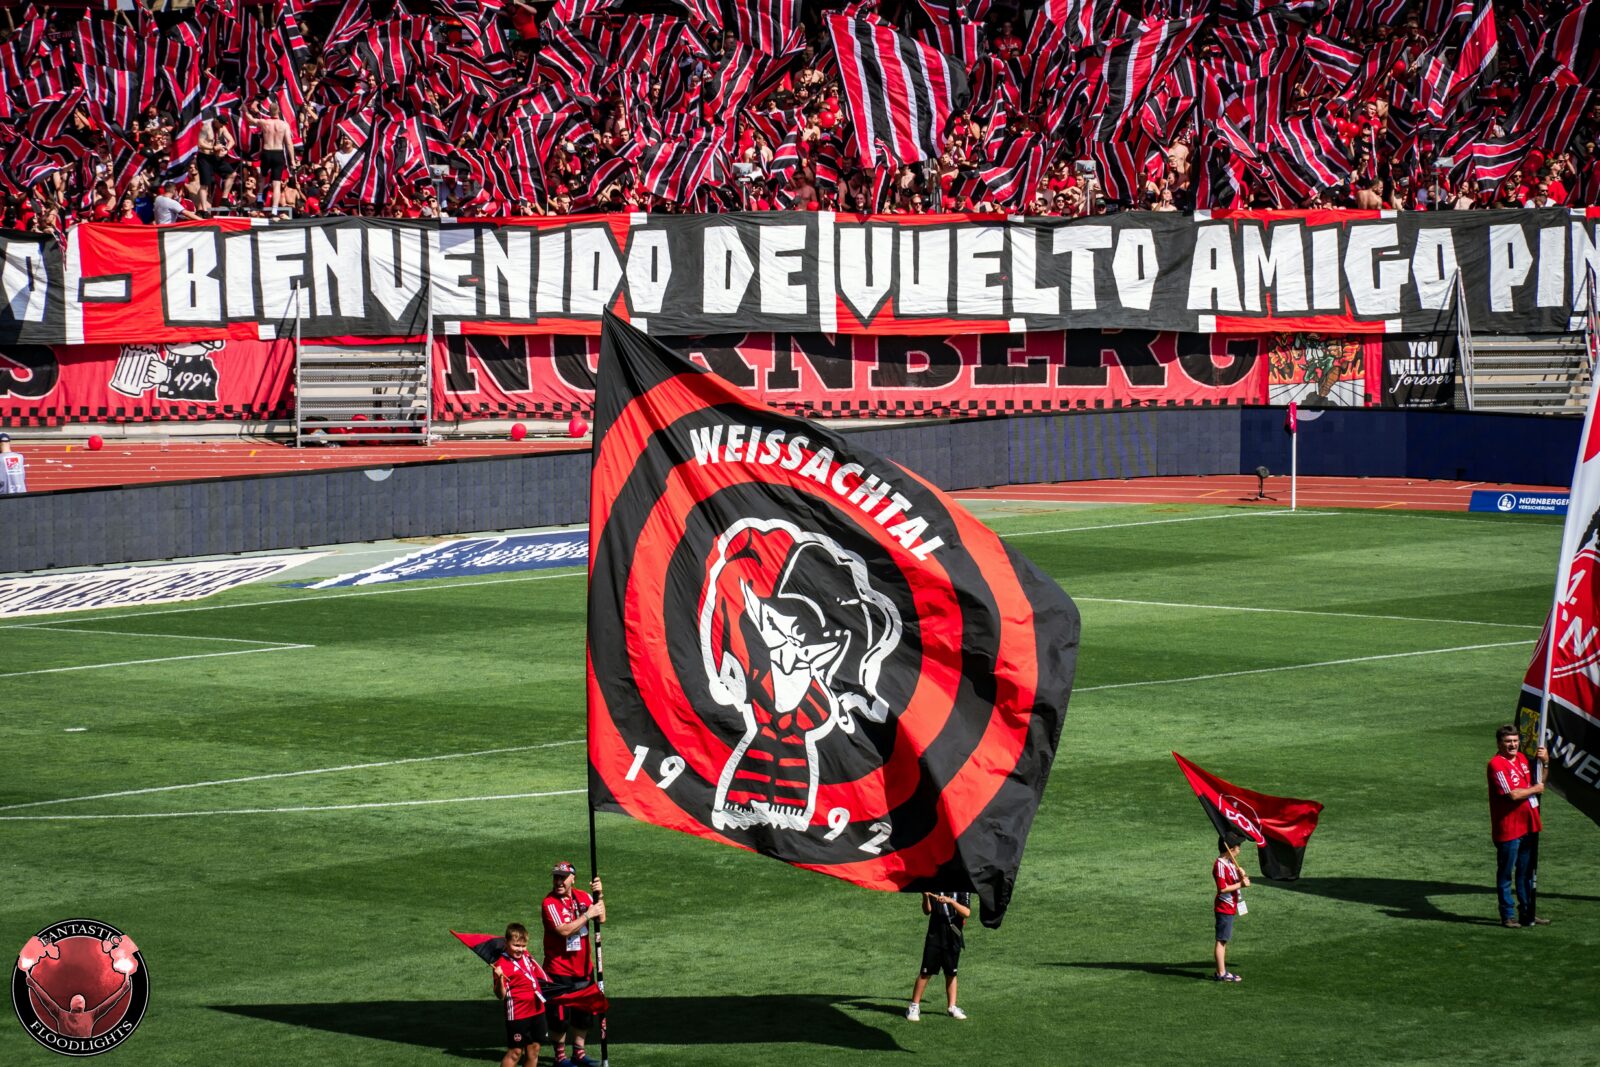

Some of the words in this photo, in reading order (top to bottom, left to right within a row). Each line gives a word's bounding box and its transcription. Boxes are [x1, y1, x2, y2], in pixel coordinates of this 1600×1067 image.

[163, 224, 672, 322] BIENVENIDO
[702, 225, 807, 315] DE
[839, 225, 1160, 320] VUELTO
[1186, 223, 1458, 316] AMIGO
[1408, 341, 1438, 358] YOU
[1389, 359, 1425, 375] WILL
[1427, 358, 1455, 375] LIVE
[174, 371, 212, 391] 1994
[690, 424, 945, 561] WEISSACHTAL
